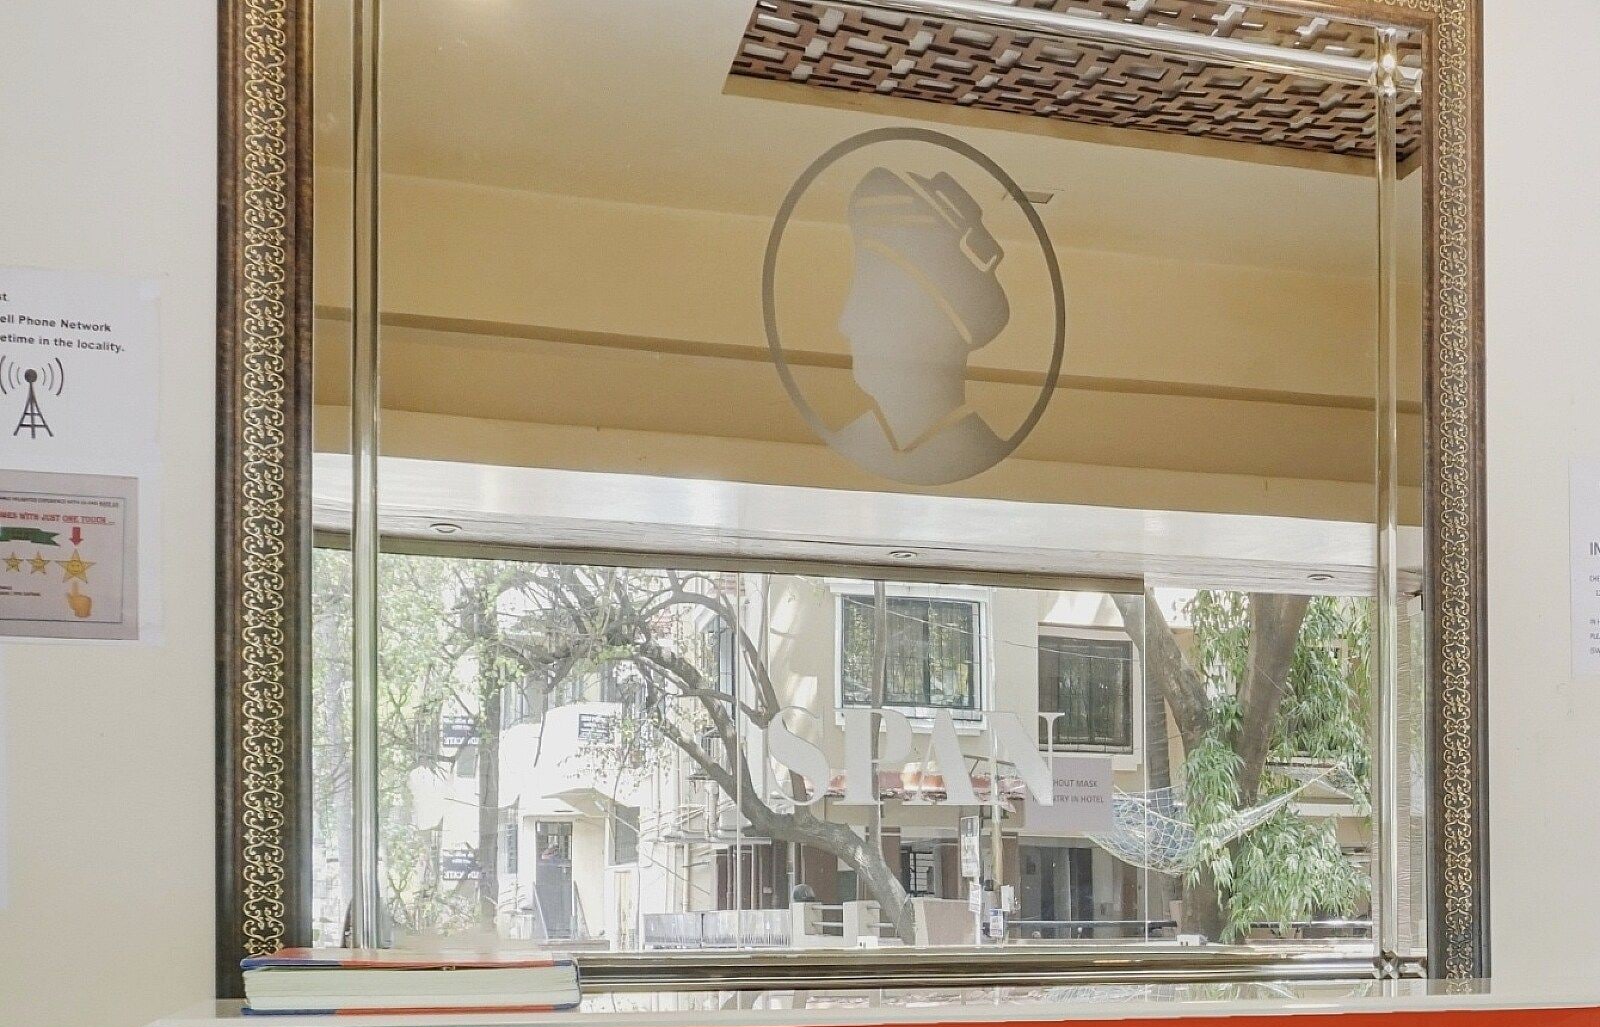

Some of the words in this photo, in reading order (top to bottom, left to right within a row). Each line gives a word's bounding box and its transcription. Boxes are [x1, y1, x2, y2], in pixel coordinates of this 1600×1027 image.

[18, 315, 56, 328] Phone
[60, 319, 112, 332] Network
[39, 336, 50, 345] in
[54, 338, 73, 348] the
[77, 339, 125, 354] locality.
[41, 514, 60, 522] JUST
[767, 705, 1066, 807] SPAN
[1077, 780, 1098, 788] MASK
[1081, 795, 1104, 803] HOTEL
